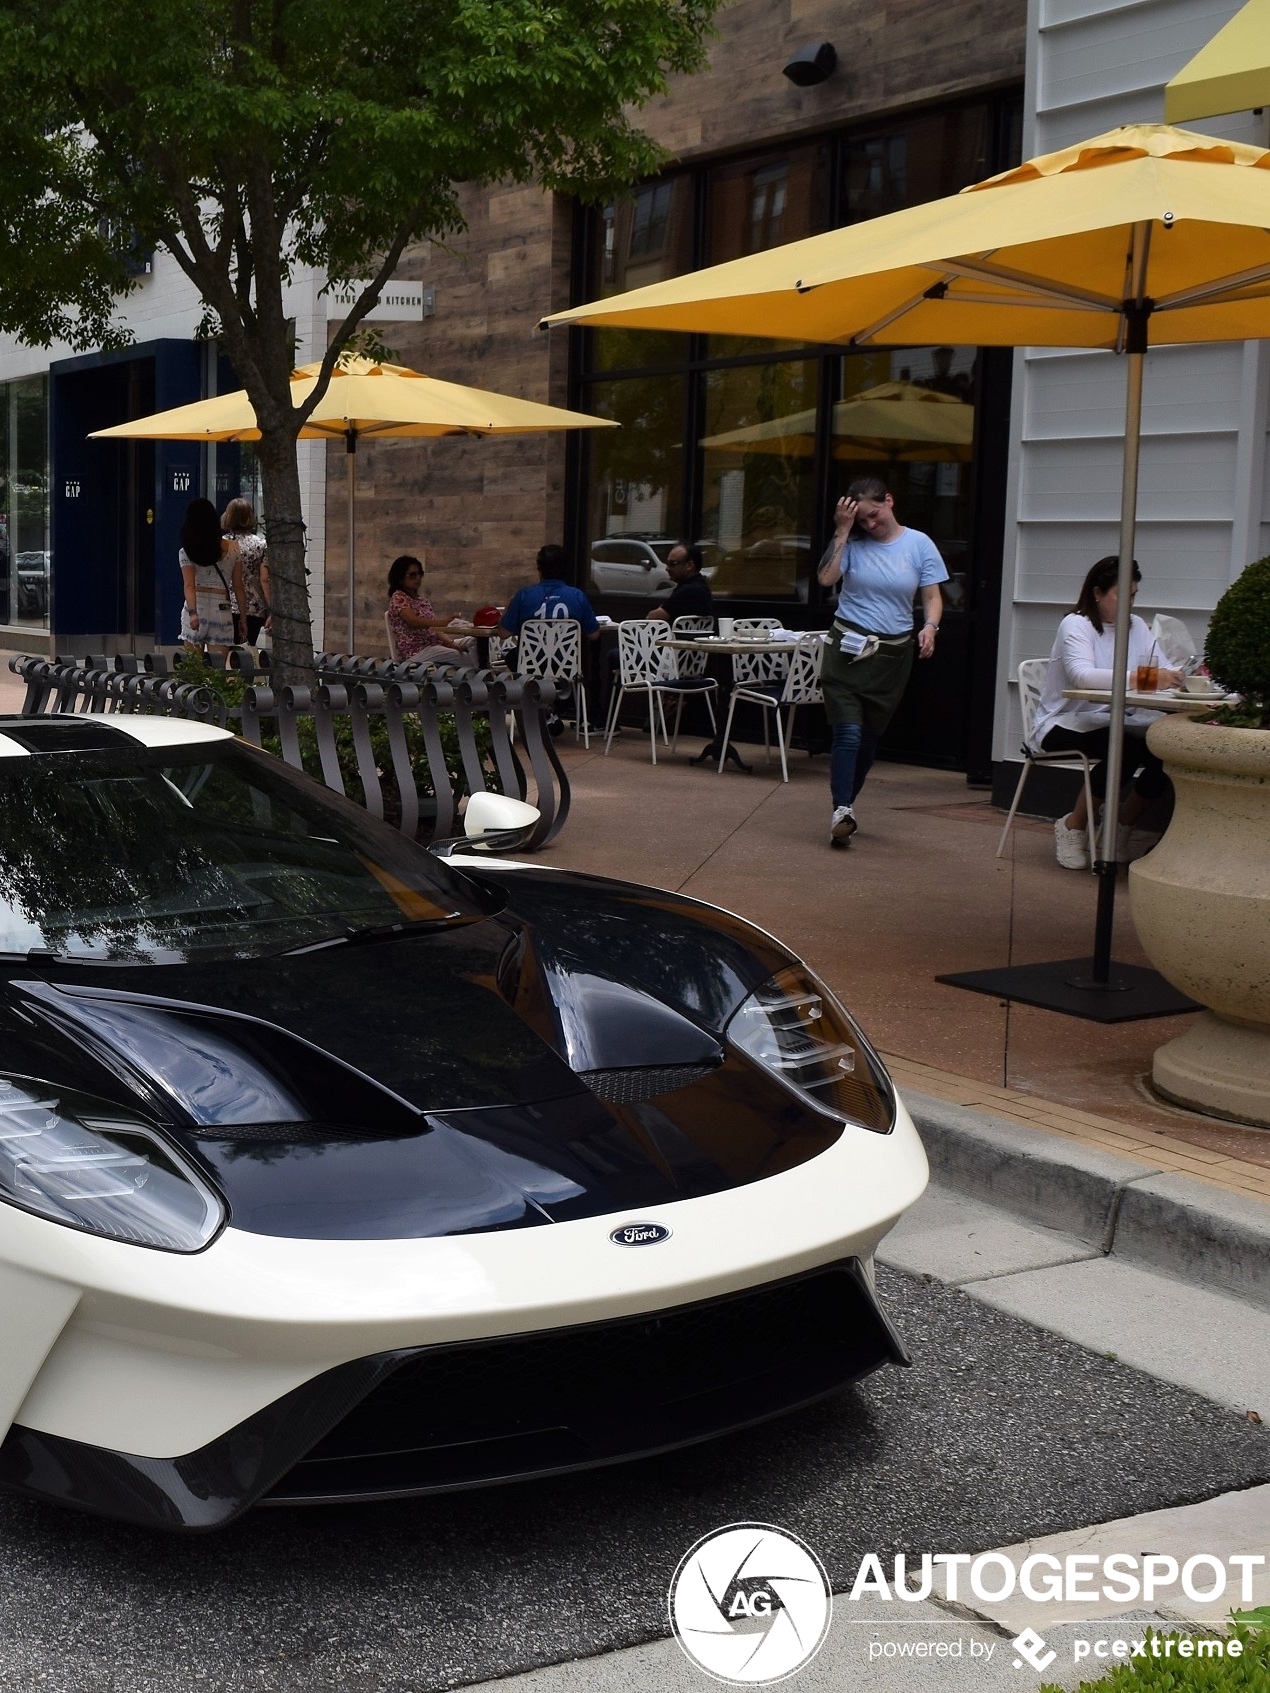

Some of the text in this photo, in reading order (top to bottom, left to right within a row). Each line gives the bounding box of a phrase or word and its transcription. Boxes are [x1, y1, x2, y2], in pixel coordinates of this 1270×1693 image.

[335, 295, 356, 304] TRUE
[386, 297, 422, 306] KITCHEN
[173, 477, 190, 491] GAP
[65, 485, 81, 498] GAP
[623, 1225, 660, 1243] Ford
